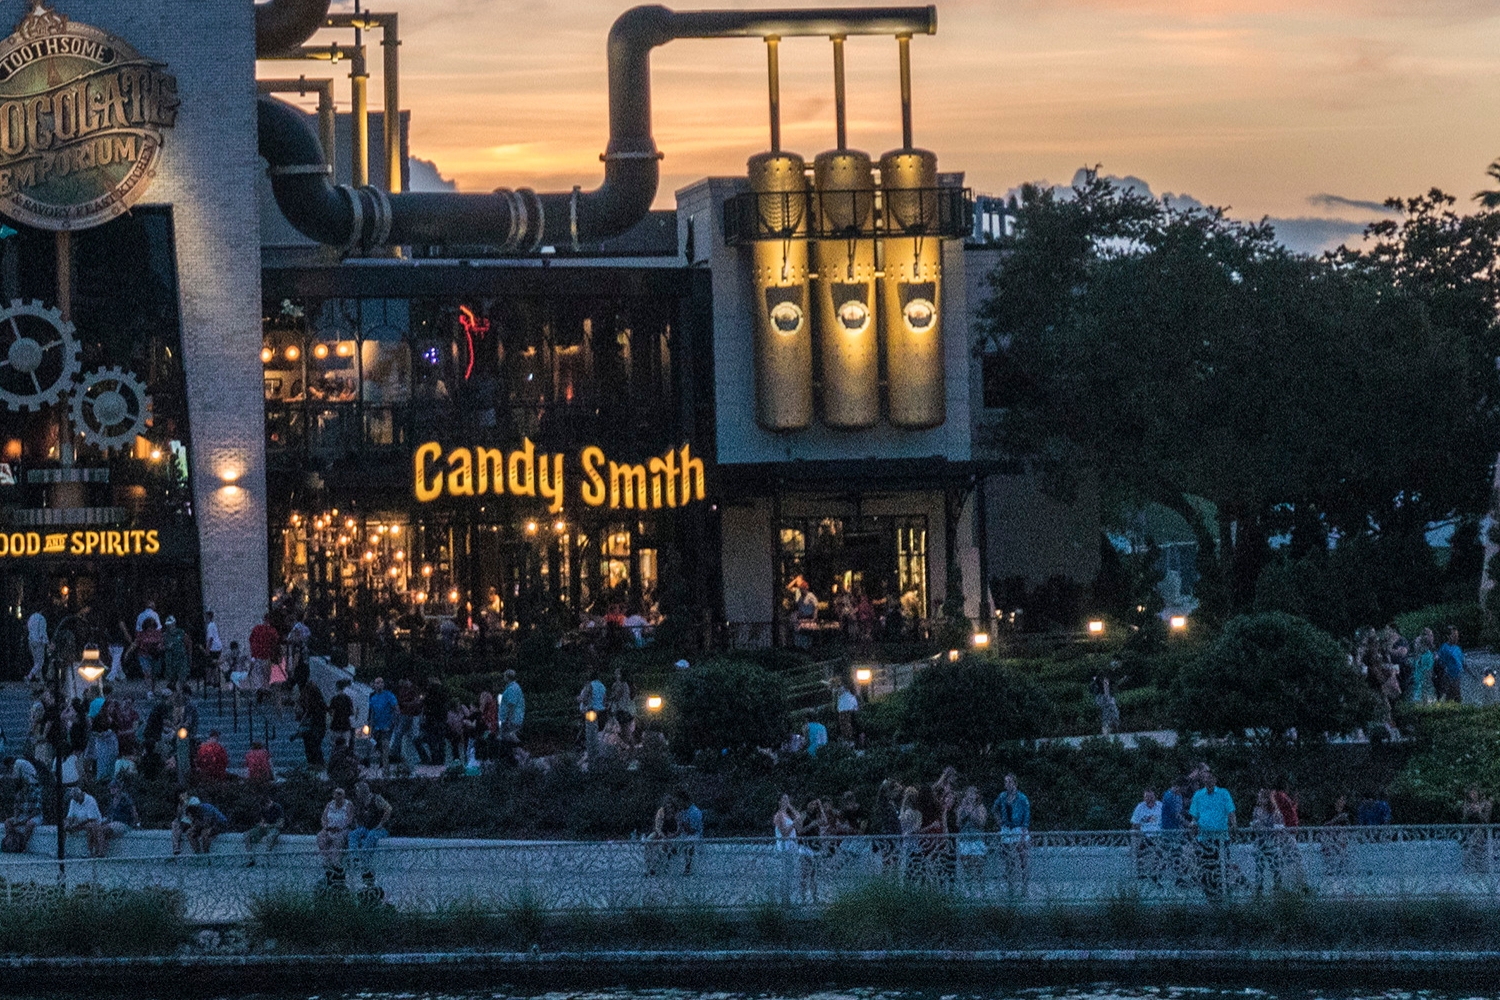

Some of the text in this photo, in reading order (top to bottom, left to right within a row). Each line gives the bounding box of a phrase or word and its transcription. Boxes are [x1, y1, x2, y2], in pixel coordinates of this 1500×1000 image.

[1, 37, 106, 73] TOOTHSOME
[23, 199, 71, 217] SAVORY
[75, 193, 117, 217] FEAST
[414, 436, 705, 513] Candy Smith
[45, 536, 66, 550] AND
[70, 530, 160, 557] SPIRITS
